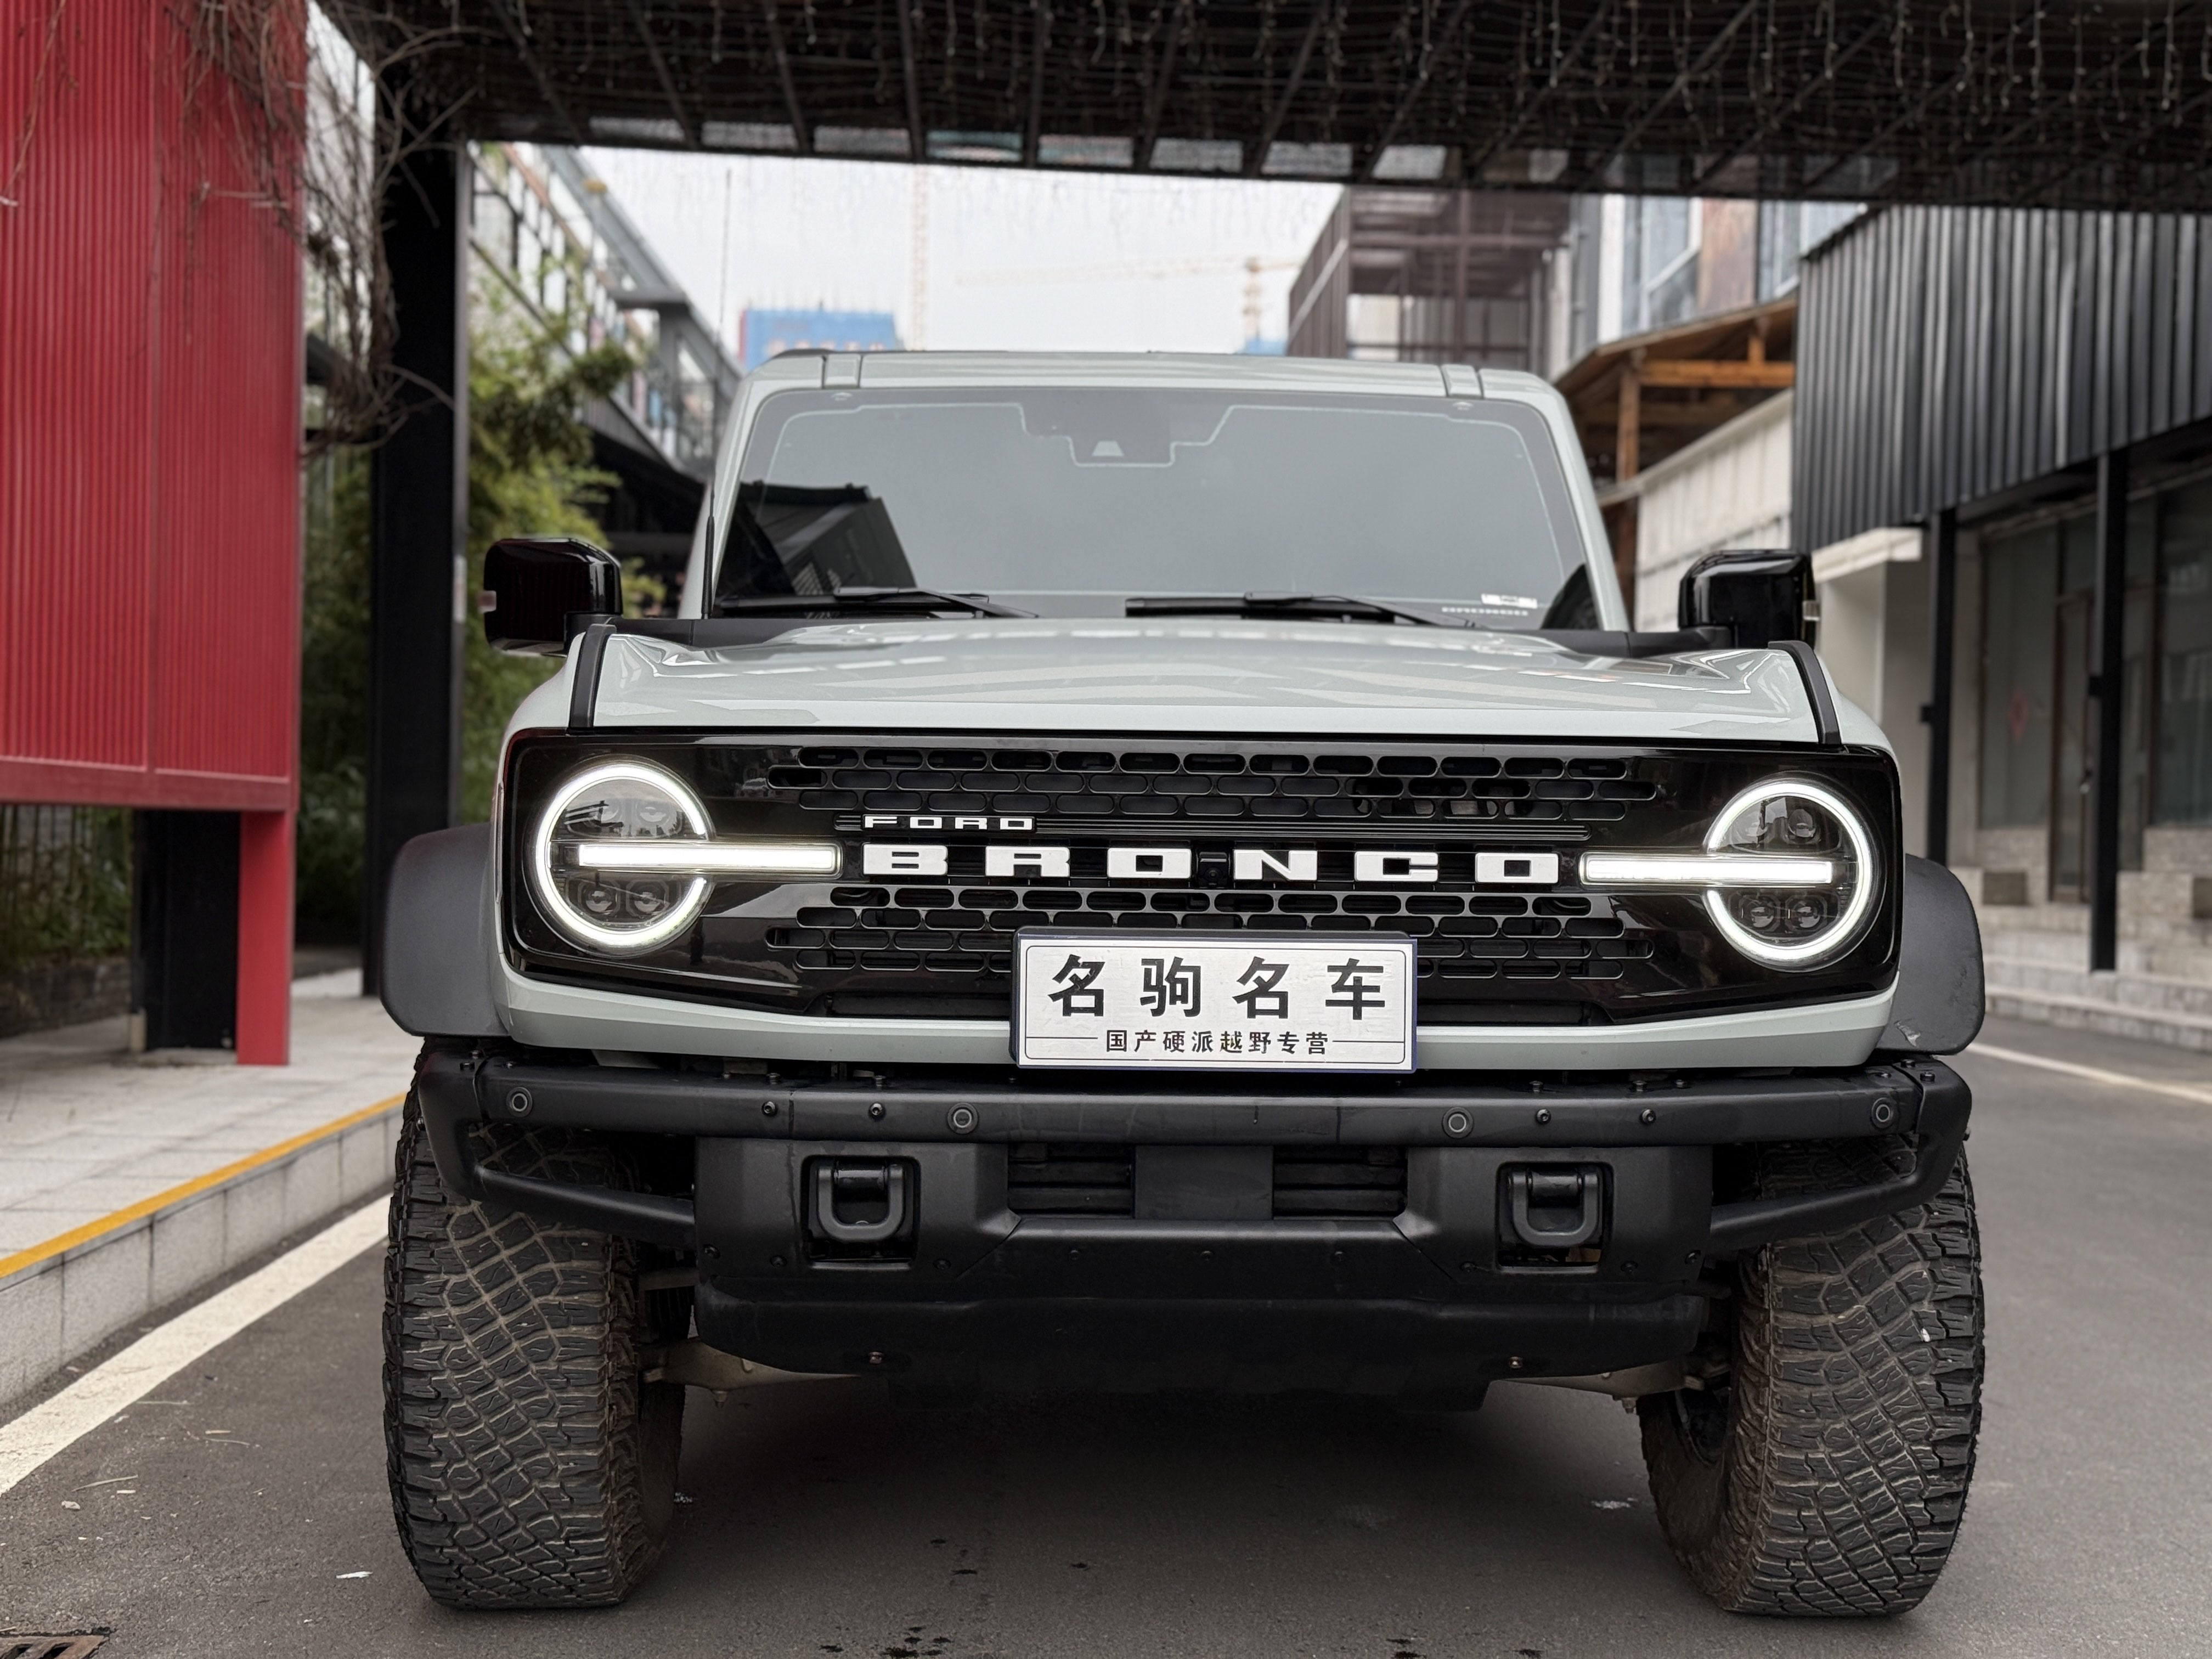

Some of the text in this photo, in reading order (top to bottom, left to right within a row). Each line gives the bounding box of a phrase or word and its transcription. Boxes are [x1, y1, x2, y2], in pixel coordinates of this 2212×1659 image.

[865, 816, 1032, 830] FORD
[863, 844, 1559, 883] BRONCO
[1048, 954, 1385, 1020] 名驹名车
[1106, 1030, 1328, 1054] 国产硬派越野专营
